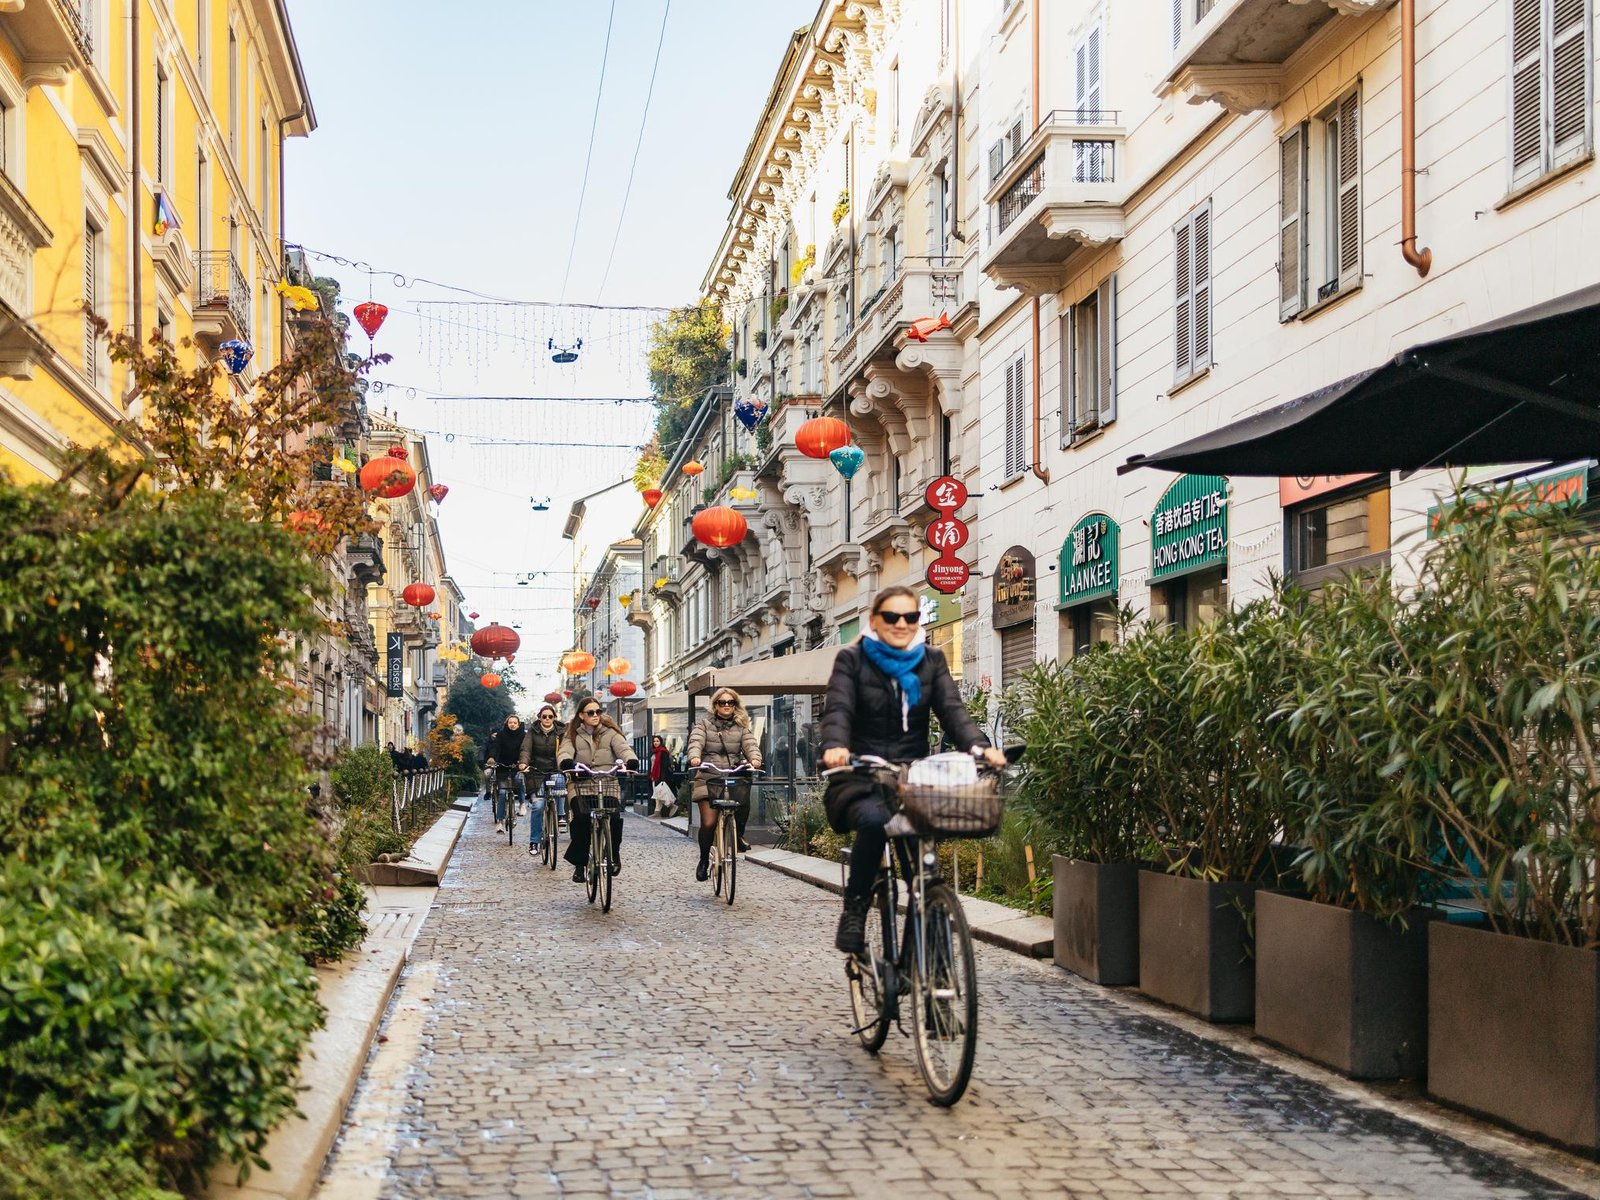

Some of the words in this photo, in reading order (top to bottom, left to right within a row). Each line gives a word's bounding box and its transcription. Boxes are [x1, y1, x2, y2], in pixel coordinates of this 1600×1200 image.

[1155, 490, 1221, 536] 香港饮品专门店
[1153, 542, 1178, 569] HONG
[1179, 533, 1204, 561] KONG
[1206, 527, 1224, 552] TEA
[932, 564, 963, 575] Jinyong
[1064, 560, 1111, 596] LAANKEE
[393, 657, 402, 690] Kaiseki
